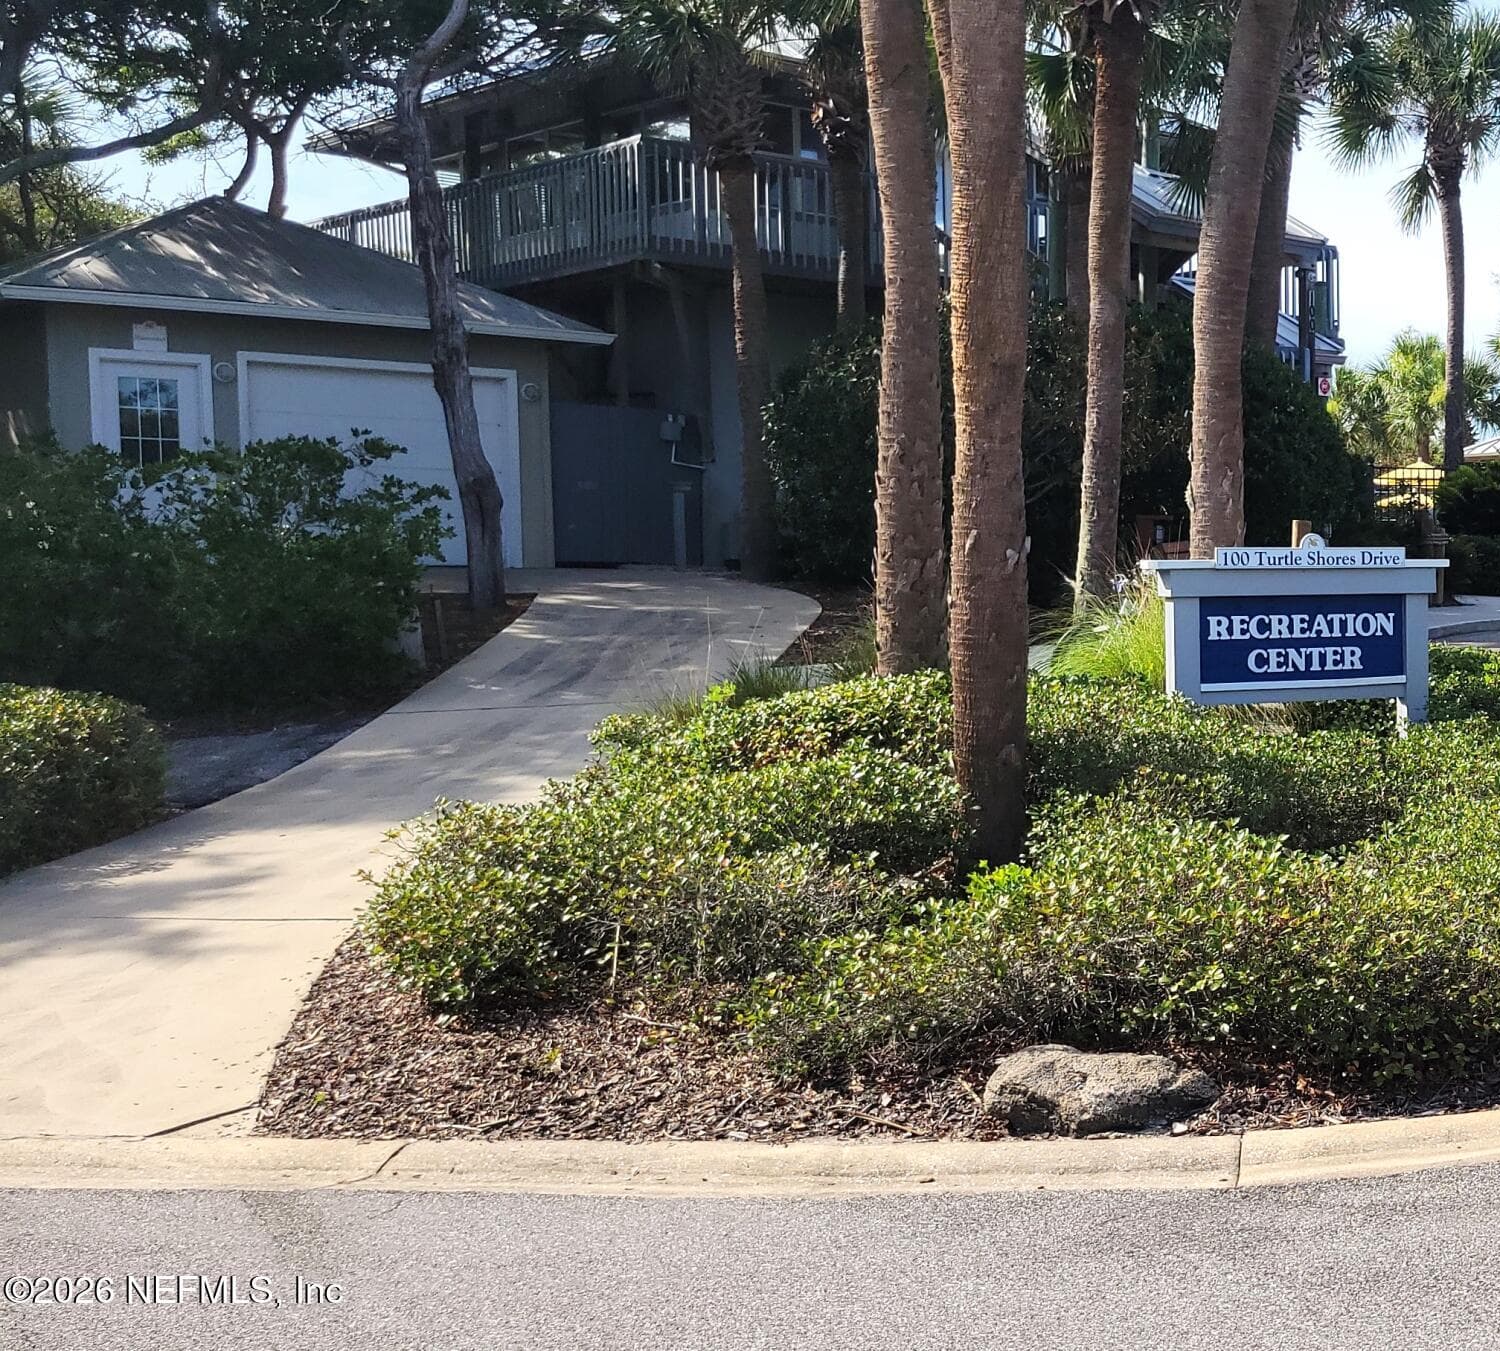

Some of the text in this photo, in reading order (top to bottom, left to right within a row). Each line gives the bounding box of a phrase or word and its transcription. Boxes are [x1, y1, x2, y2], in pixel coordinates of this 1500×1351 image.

[1222, 550, 1400, 567] 100 Turtle Shores Drive
[1206, 612, 1395, 641] RECREATION
[1247, 646, 1363, 673] CENTER
